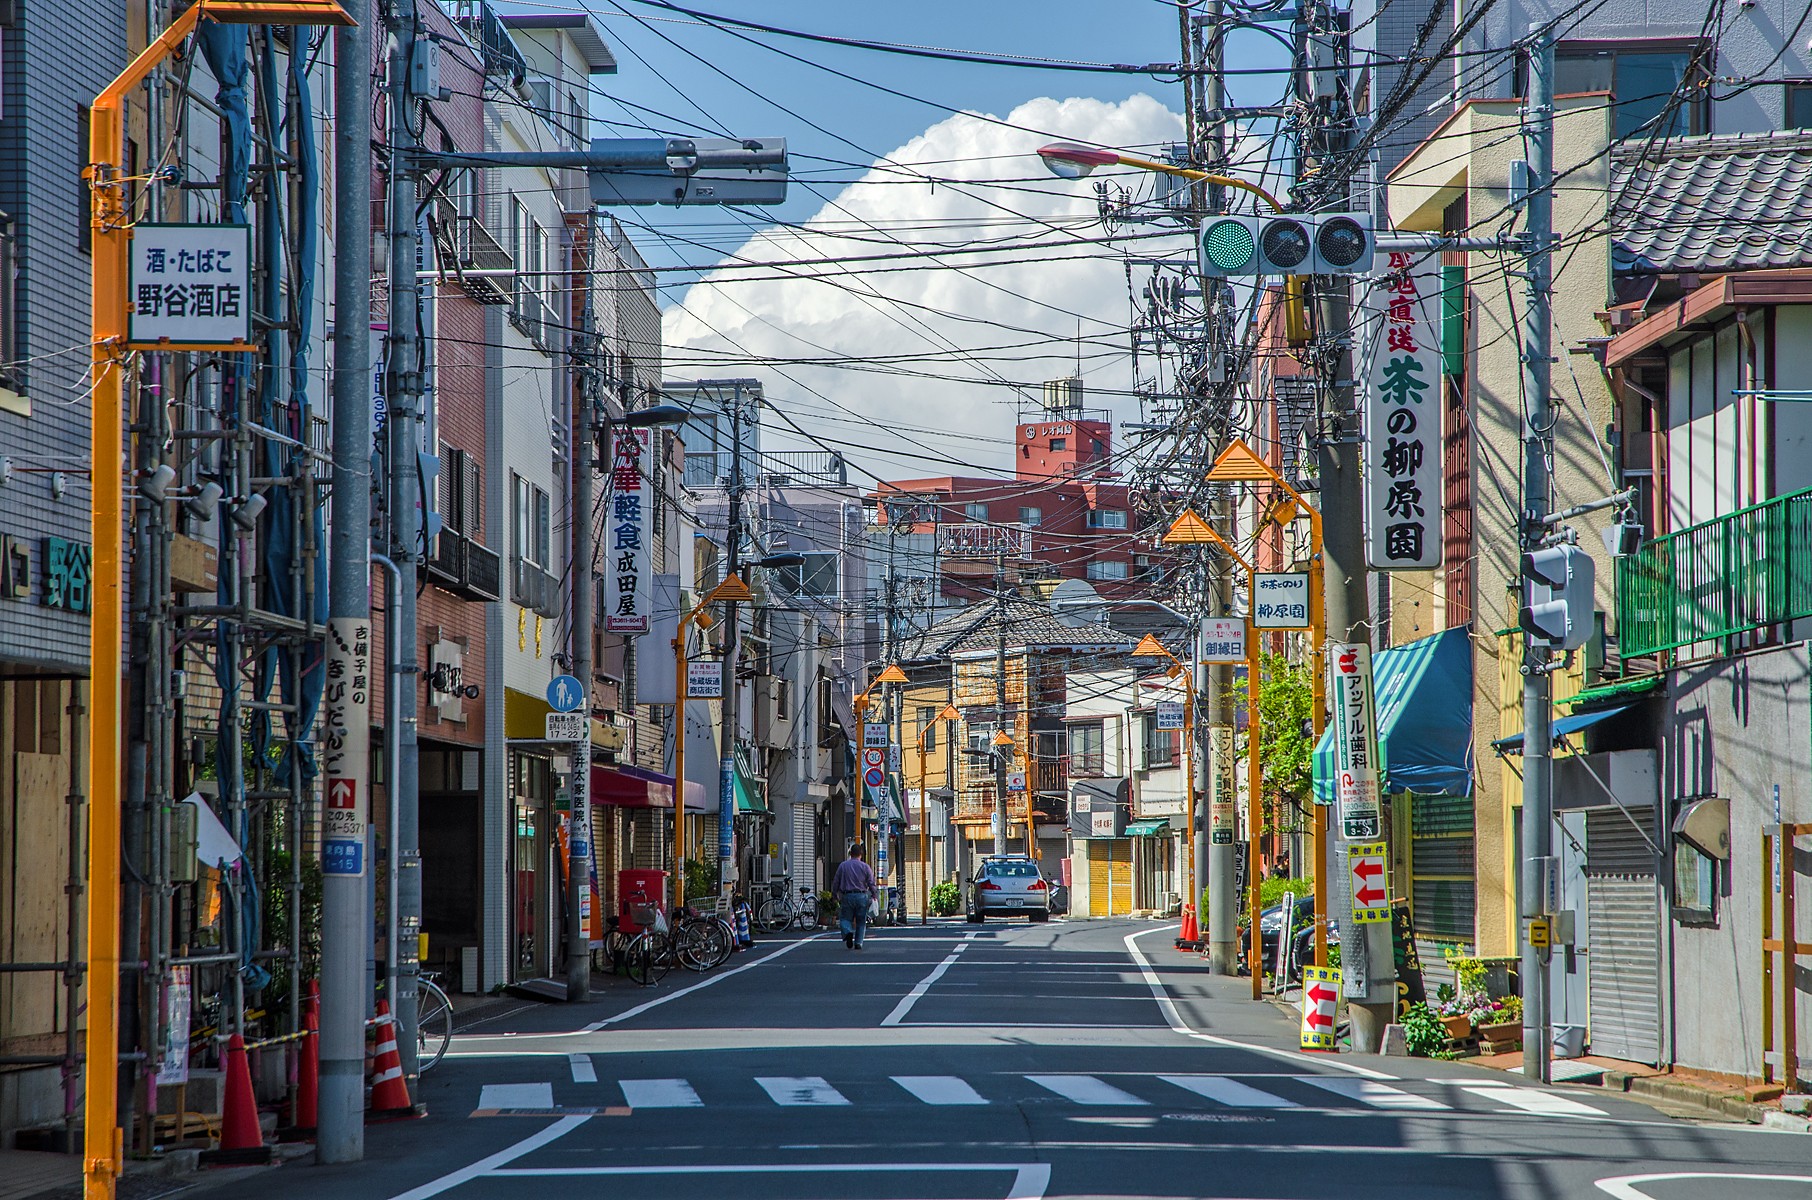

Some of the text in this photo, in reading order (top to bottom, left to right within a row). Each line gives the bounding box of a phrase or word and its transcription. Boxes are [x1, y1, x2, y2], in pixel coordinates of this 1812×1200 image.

[146, 248, 231, 273] 酒・たばこ
[138, 283, 241, 317] 野谷酒店
[48, 536, 92, 612] 野谷
[1260, 579, 1303, 590] お茶とのり
[1257, 604, 1305, 619] 柳原園
[1205, 642, 1241, 655] 御縁日
[689, 677, 720, 685] 地蔵坂通
[689, 686, 720, 695] 商店街で
[326, 660, 346, 775] きびだんご
[1347, 675, 1368, 769] アップル歯科
[870, 753, 881, 761] 30
[327, 811, 356, 821] この先
[1350, 846, 1384, 855] 売物件
[1305, 969, 1341, 981] 売物件
